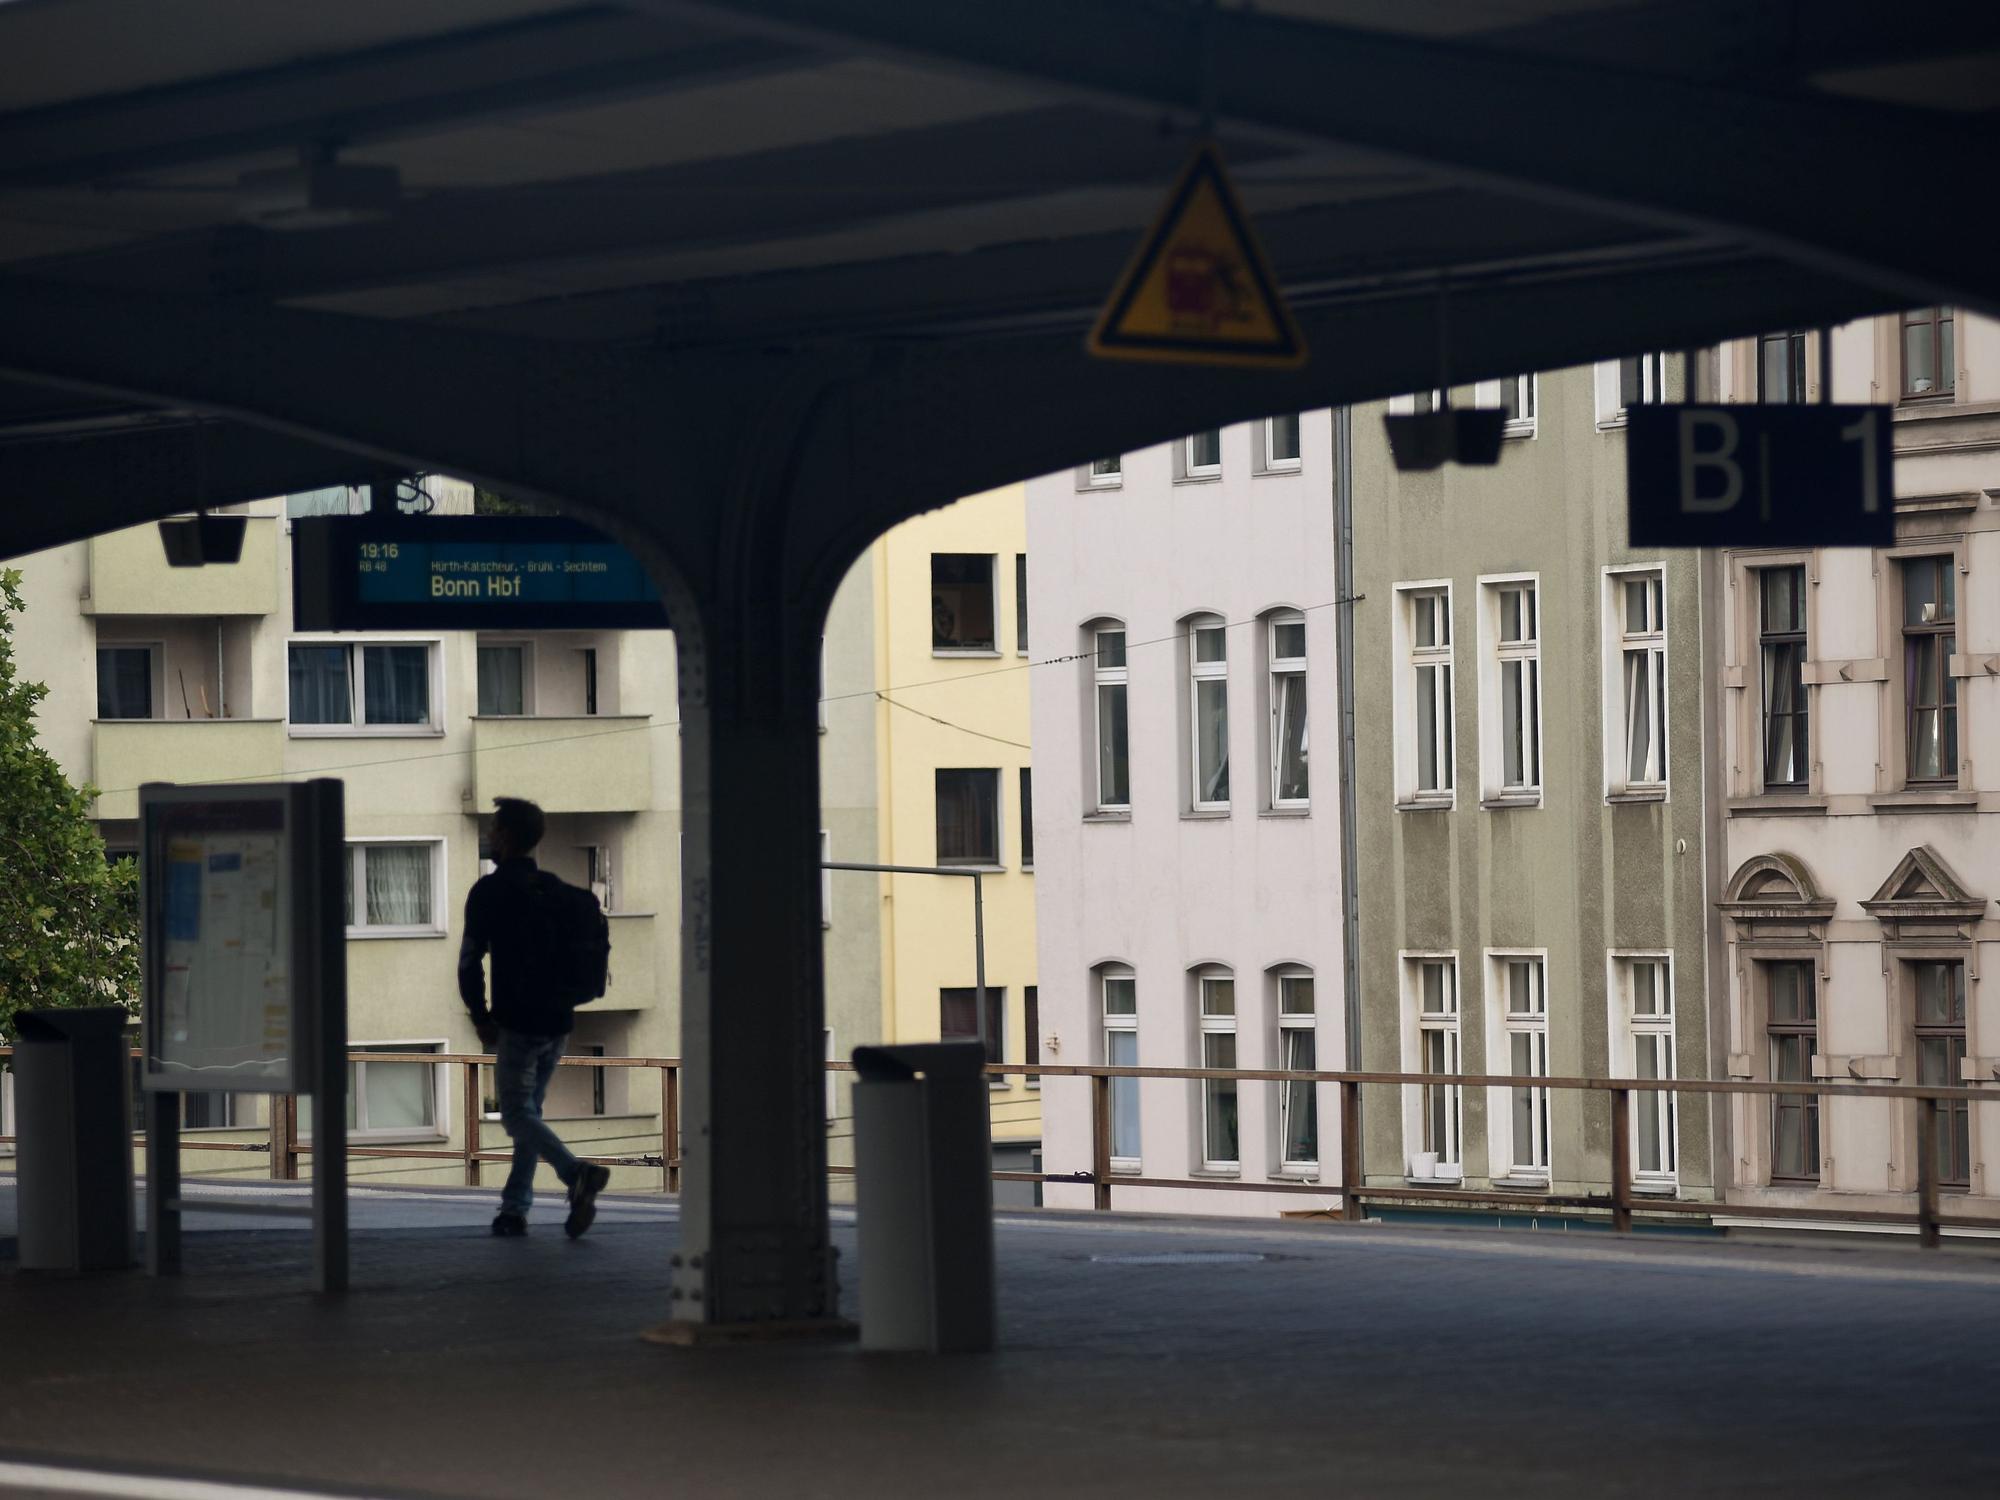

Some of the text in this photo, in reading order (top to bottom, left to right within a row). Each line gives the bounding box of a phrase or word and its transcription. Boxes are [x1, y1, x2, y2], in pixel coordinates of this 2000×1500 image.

[1679, 410, 1879, 513] B 1
[360, 543, 398, 559] 19:16
[563, 560, 607, 572] Sechtem
[432, 576, 521, 597] Bonn Hbf
